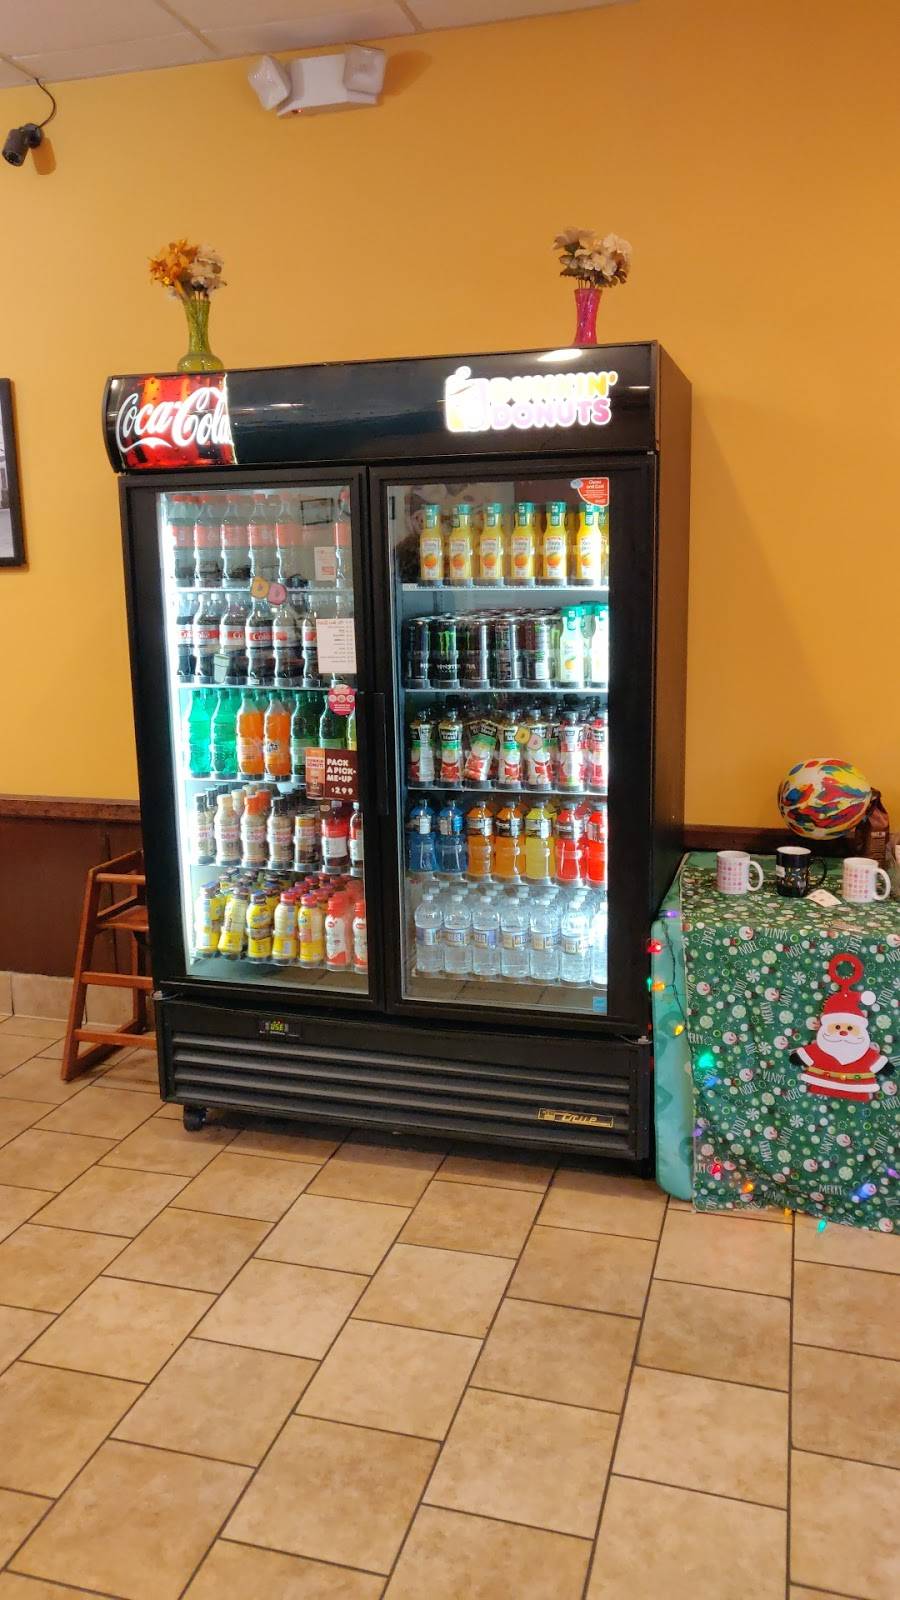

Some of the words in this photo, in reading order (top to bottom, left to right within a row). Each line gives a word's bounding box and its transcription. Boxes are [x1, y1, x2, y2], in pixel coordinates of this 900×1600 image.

[491, 398, 612, 430] DONUTS
[327, 758, 349, 767] PACK
[327, 766, 333, 774] A
[738, 940, 759, 956] NOEL
[739, 1081, 758, 1096] NOEL
[818, 1184, 843, 1196] MERRY
